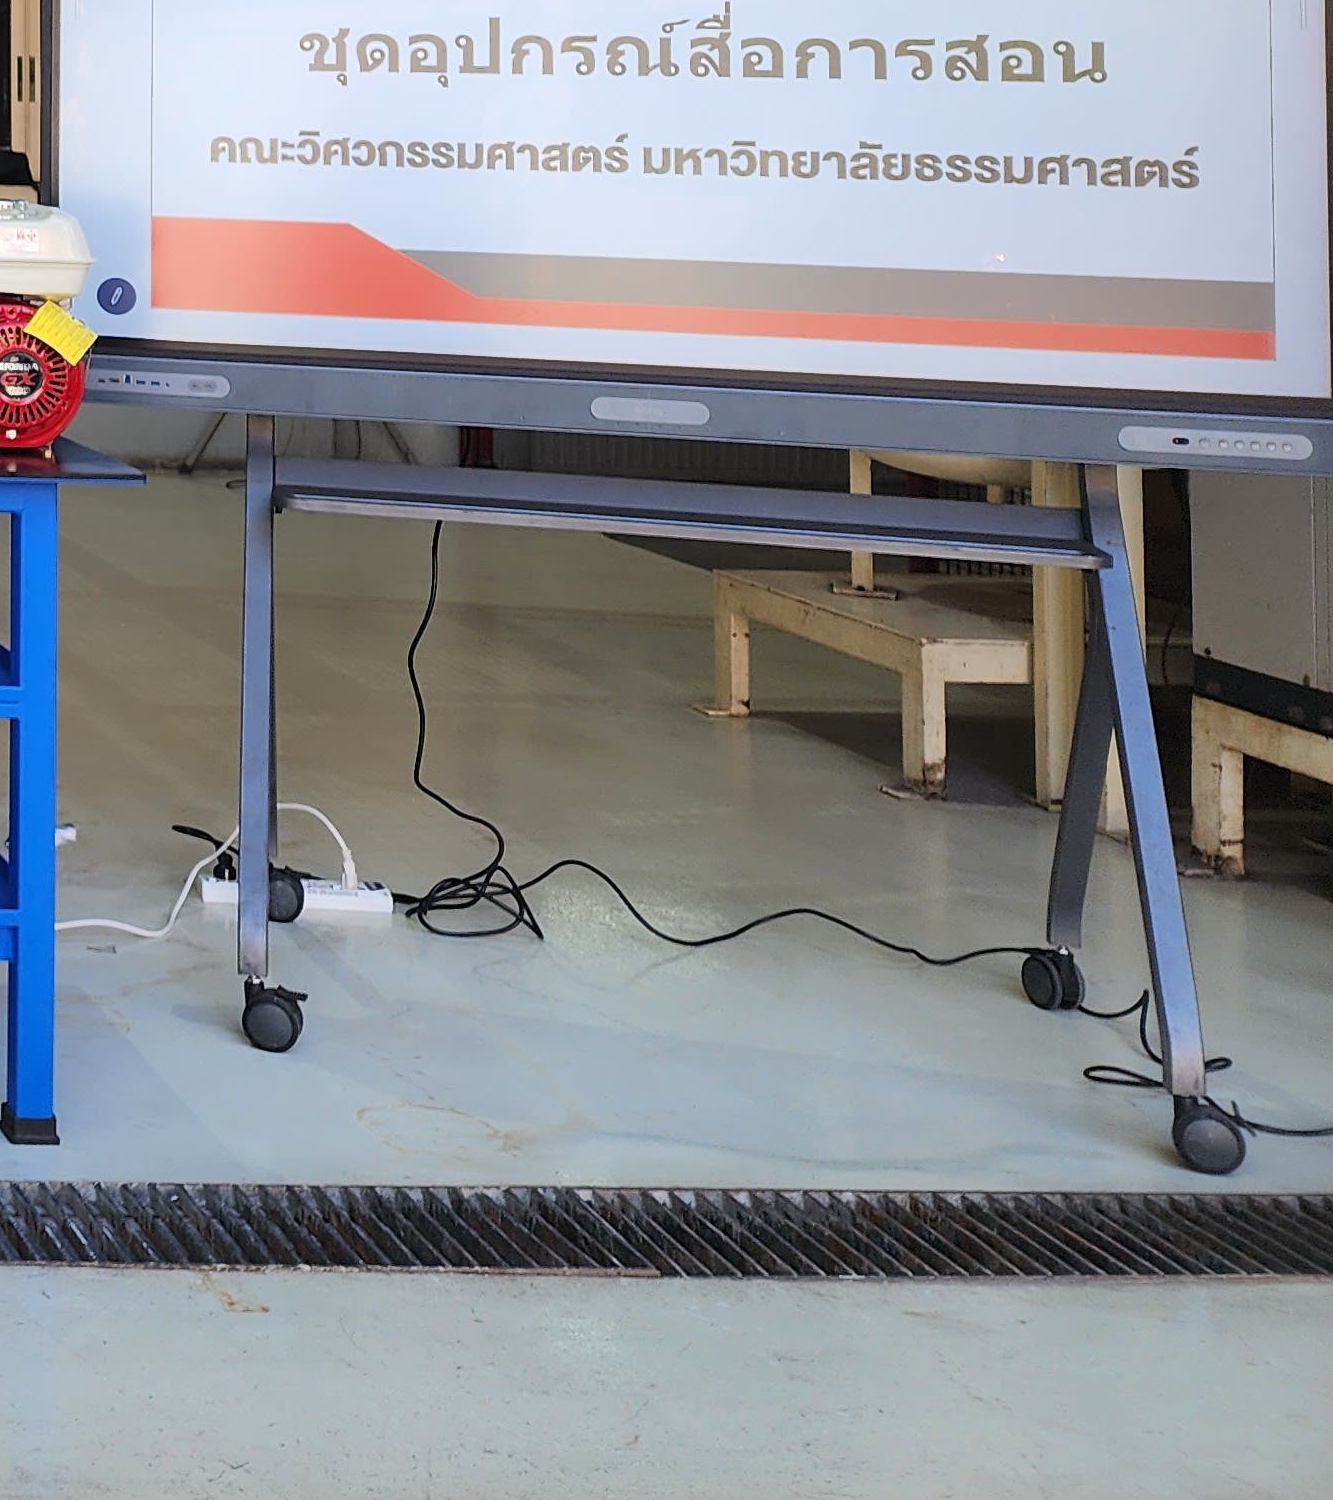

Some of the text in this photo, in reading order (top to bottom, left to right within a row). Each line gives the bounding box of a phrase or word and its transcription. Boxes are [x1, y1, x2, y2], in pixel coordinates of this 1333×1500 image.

[299, 1, 1108, 87] ชุดอุปกรณ์สื่อการสอน
[210, 131, 1200, 189] คณะวิศวกรรมศาสตร์ มหาวิทยาลัยธรรมศาสตร์
[0, 372, 37, 386] GX
